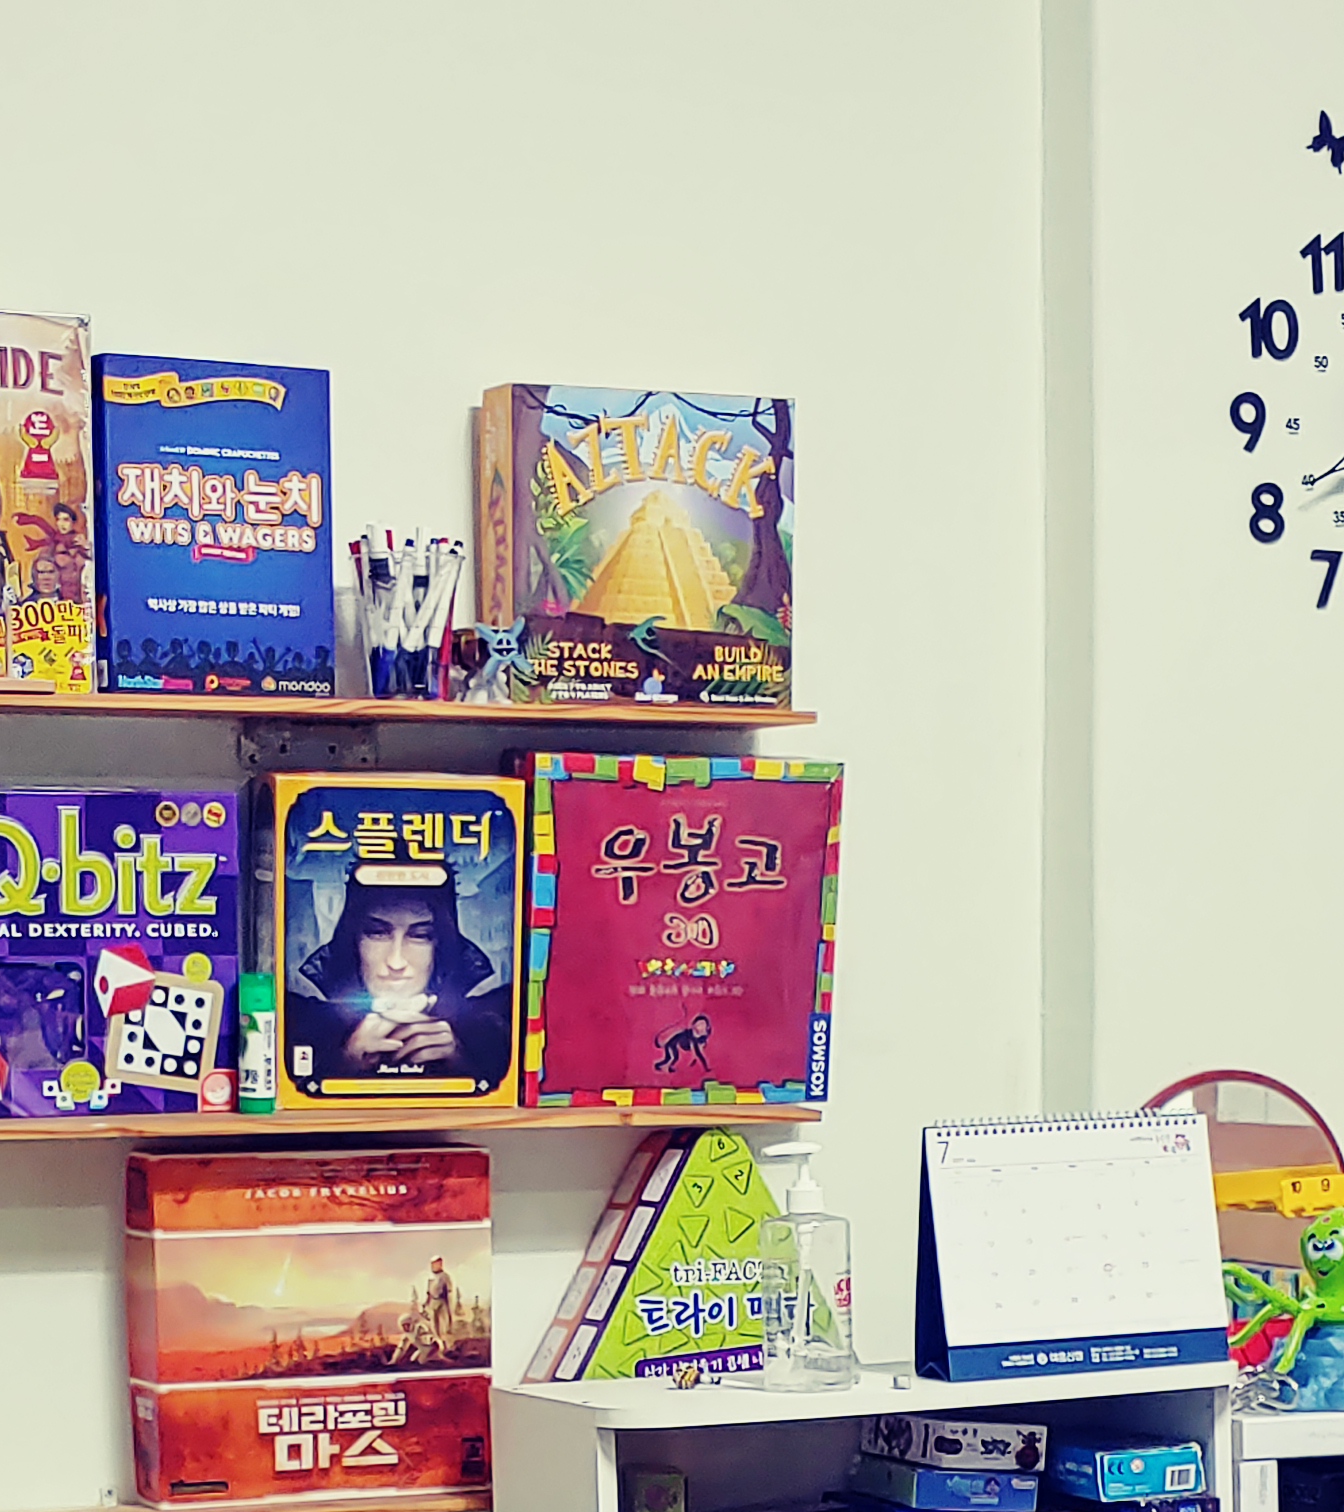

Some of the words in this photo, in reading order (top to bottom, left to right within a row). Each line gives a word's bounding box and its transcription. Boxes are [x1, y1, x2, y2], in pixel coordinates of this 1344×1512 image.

[1299, 231, 1344, 295] 11
[1238, 297, 1299, 361] 10
[1313, 355, 1329, 369] 50
[1229, 391, 1266, 453] 9
[1285, 418, 1300, 432] 45
[545, 413, 777, 519] AZTACK
[118, 464, 239, 522] 재치와
[240, 468, 323, 529] 눈치
[1249, 482, 1285, 543] 8
[128, 517, 192, 546] WITS
[215, 521, 317, 553] WAGERS
[1310, 549, 1343, 609] 7
[547, 642, 613, 660] STACK
[563, 660, 639, 680] STONES
[714, 646, 762, 664] BUILD
[692, 665, 723, 682] AN
[722, 664, 785, 683] EMPIRE
[301, 811, 494, 862] 스플렌더
[592, 814, 788, 908] 우봉고
[809, 1018, 828, 1098] KOSMOS
[717, 1139, 726, 1151] 6
[937, 1141, 949, 1164] 7
[1321, 1178, 1331, 1192] 9
[638, 1292, 737, 1336] 트라이
[256, 1400, 407, 1434] 테라포밍
[274, 1430, 400, 1473] 마스
